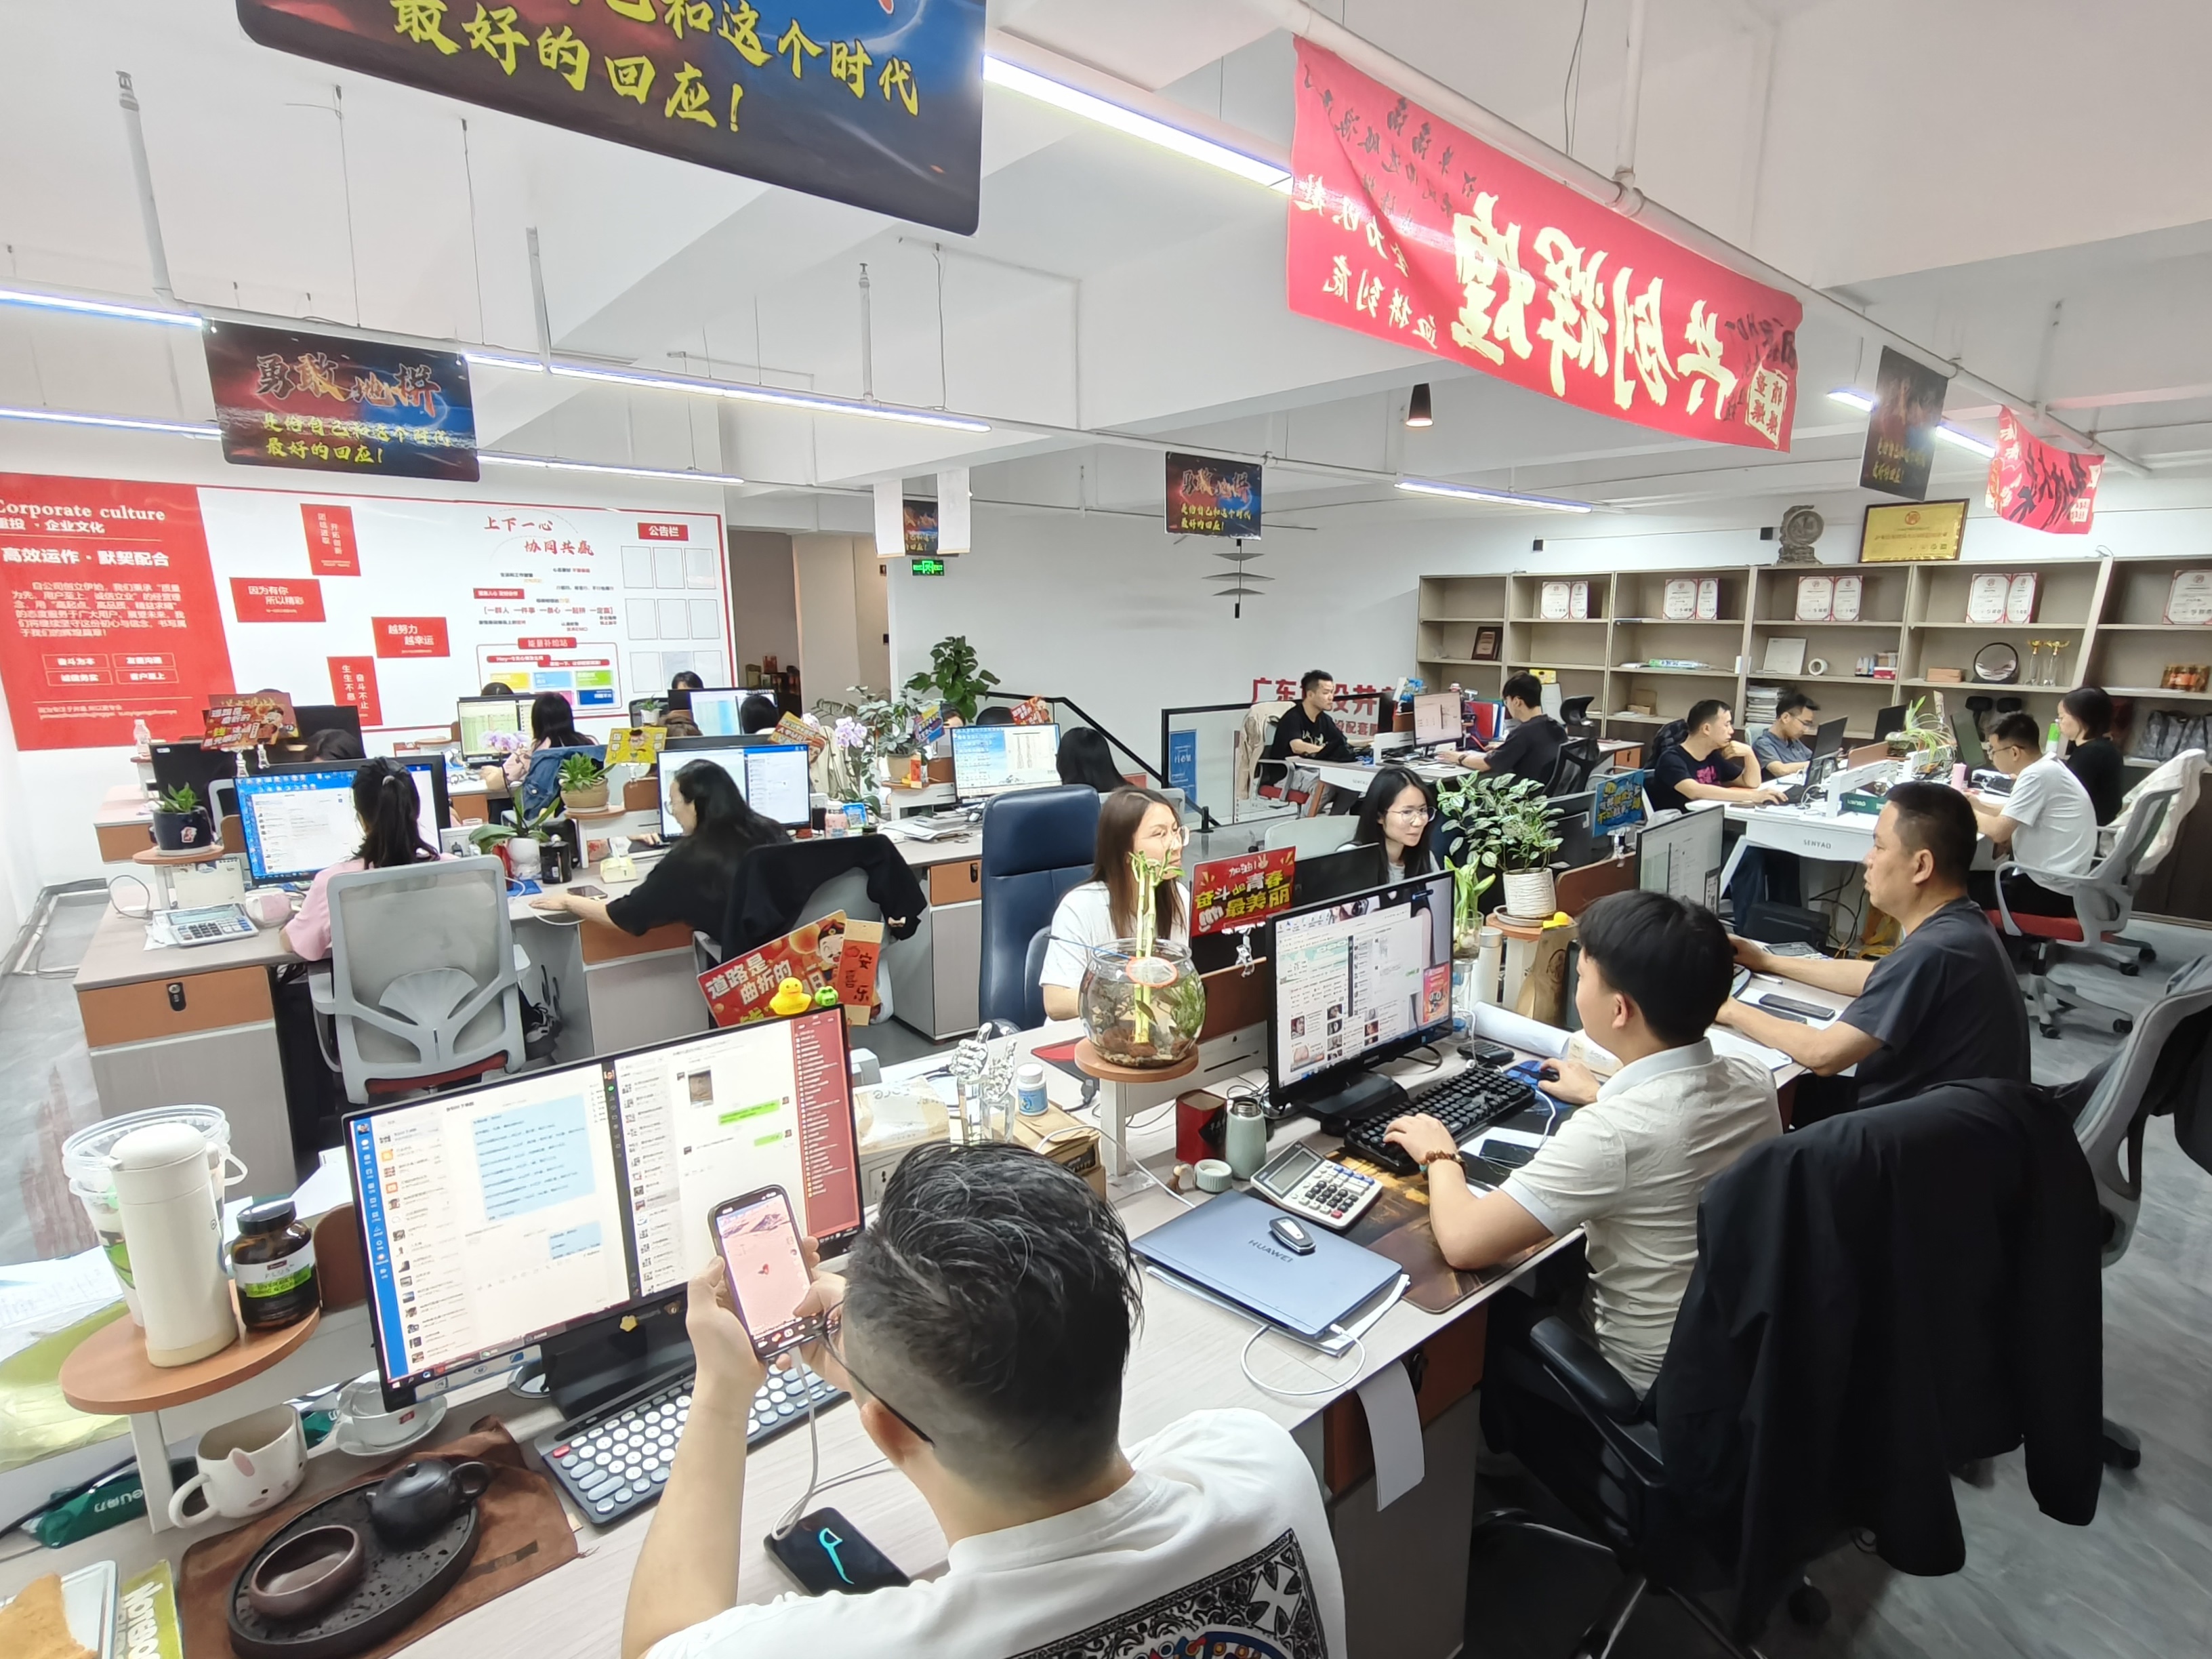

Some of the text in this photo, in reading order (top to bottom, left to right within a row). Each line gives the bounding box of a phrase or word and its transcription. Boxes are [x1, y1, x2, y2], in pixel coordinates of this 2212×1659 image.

[256, 352, 442, 417] 勇敢地拼
[100, 504, 165, 520] culture
[484, 516, 554, 533] 上下一心
[648, 525, 680, 537] 公告栏
[524, 540, 595, 556] 协同共赢
[248, 585, 289, 596] 因为有你
[265, 596, 304, 606] 所以精彩
[388, 624, 417, 635] 越努力
[405, 636, 434, 645] 越幸运
[342, 665, 356, 701] 生生不息
[356, 674, 369, 710] 奋斗不止
[1803, 839, 1832, 849] SENYAO
[1195, 869, 1284, 909] 奋斗de青春
[1225, 883, 1290, 918] 最美丽
[705, 952, 769, 1000] 道路是
[739, 959, 792, 1005] 曲折的
[1248, 1238, 1294, 1263] HUAWEI
